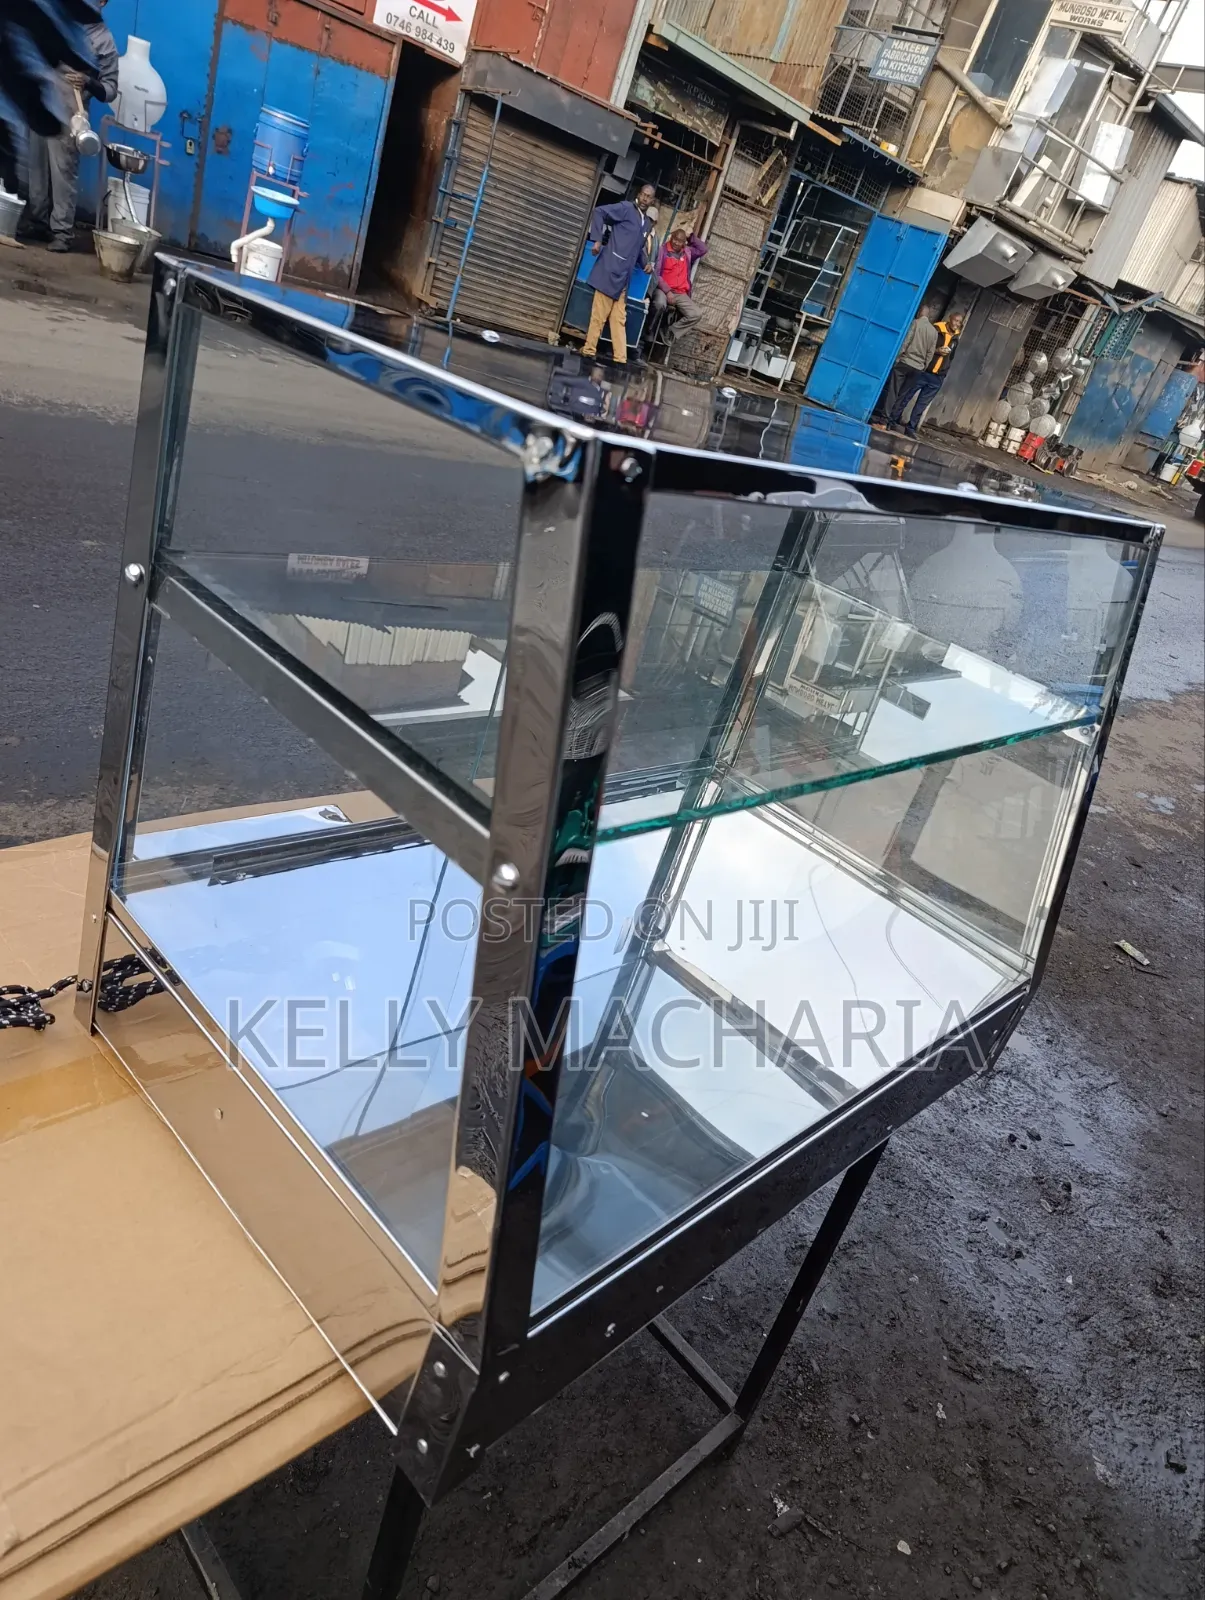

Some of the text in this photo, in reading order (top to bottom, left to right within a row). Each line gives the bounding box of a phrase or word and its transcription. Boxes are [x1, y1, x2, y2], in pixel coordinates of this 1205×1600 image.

[409, 5, 439, 29] CALL
[1069, 15, 1104, 27] WORKS
[386, 12, 455, 54] 0746 984 439
[881, 48, 930, 66] FABRICATORS
[876, 68, 919, 83] APPLIANCES
[879, 58, 924, 76] IN KITCHEN
